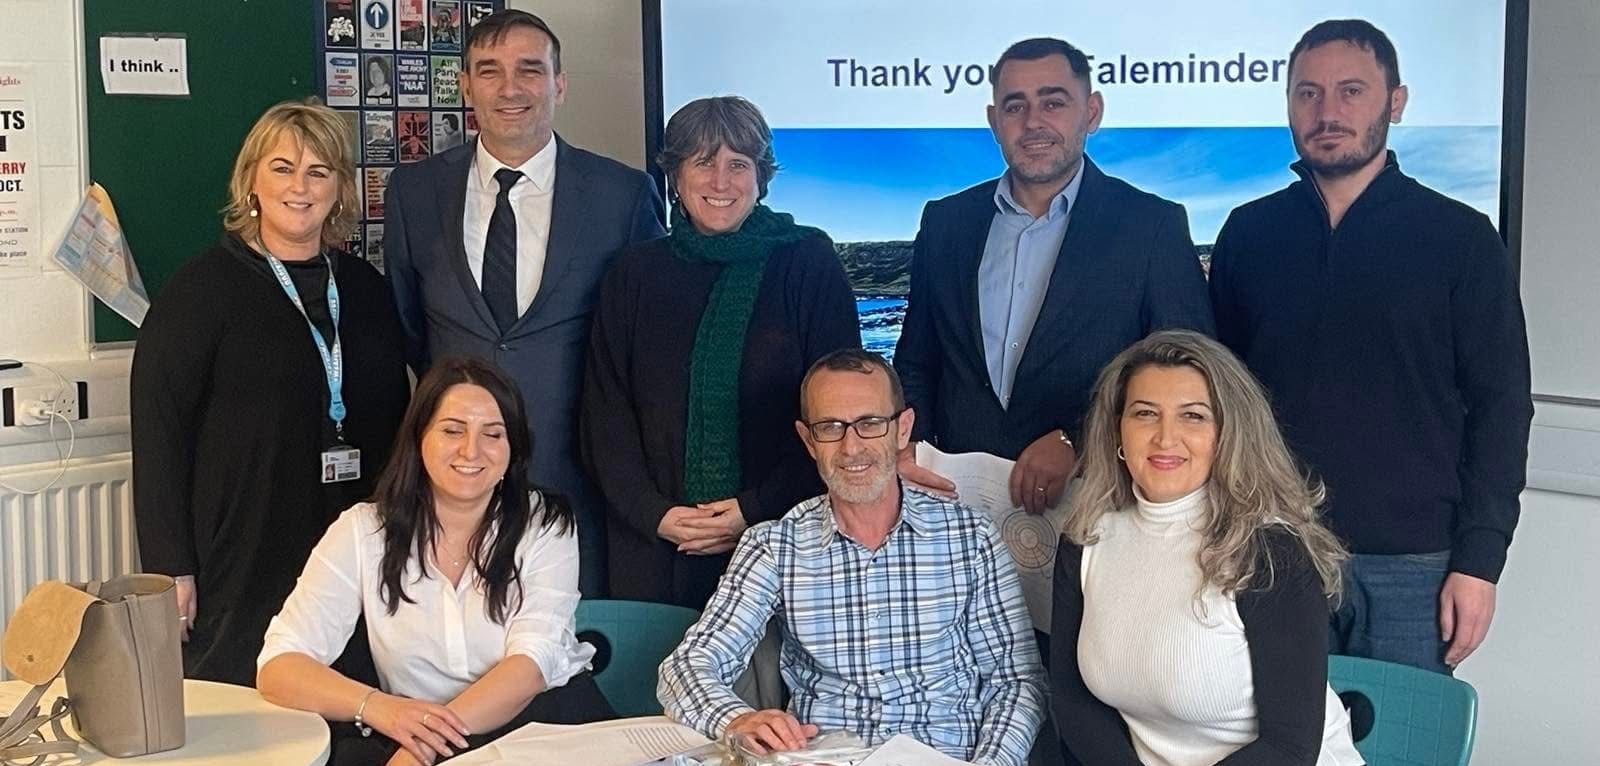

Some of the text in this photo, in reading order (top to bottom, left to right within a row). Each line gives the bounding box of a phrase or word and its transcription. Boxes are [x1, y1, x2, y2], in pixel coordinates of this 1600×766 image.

[109, 59, 115, 72] I
[121, 59, 164, 73] think
[827, 57, 932, 87] Thank
[1087, 52, 1287, 84] aleminder
[434, 68, 458, 79] Party
[437, 96, 458, 104] Now
